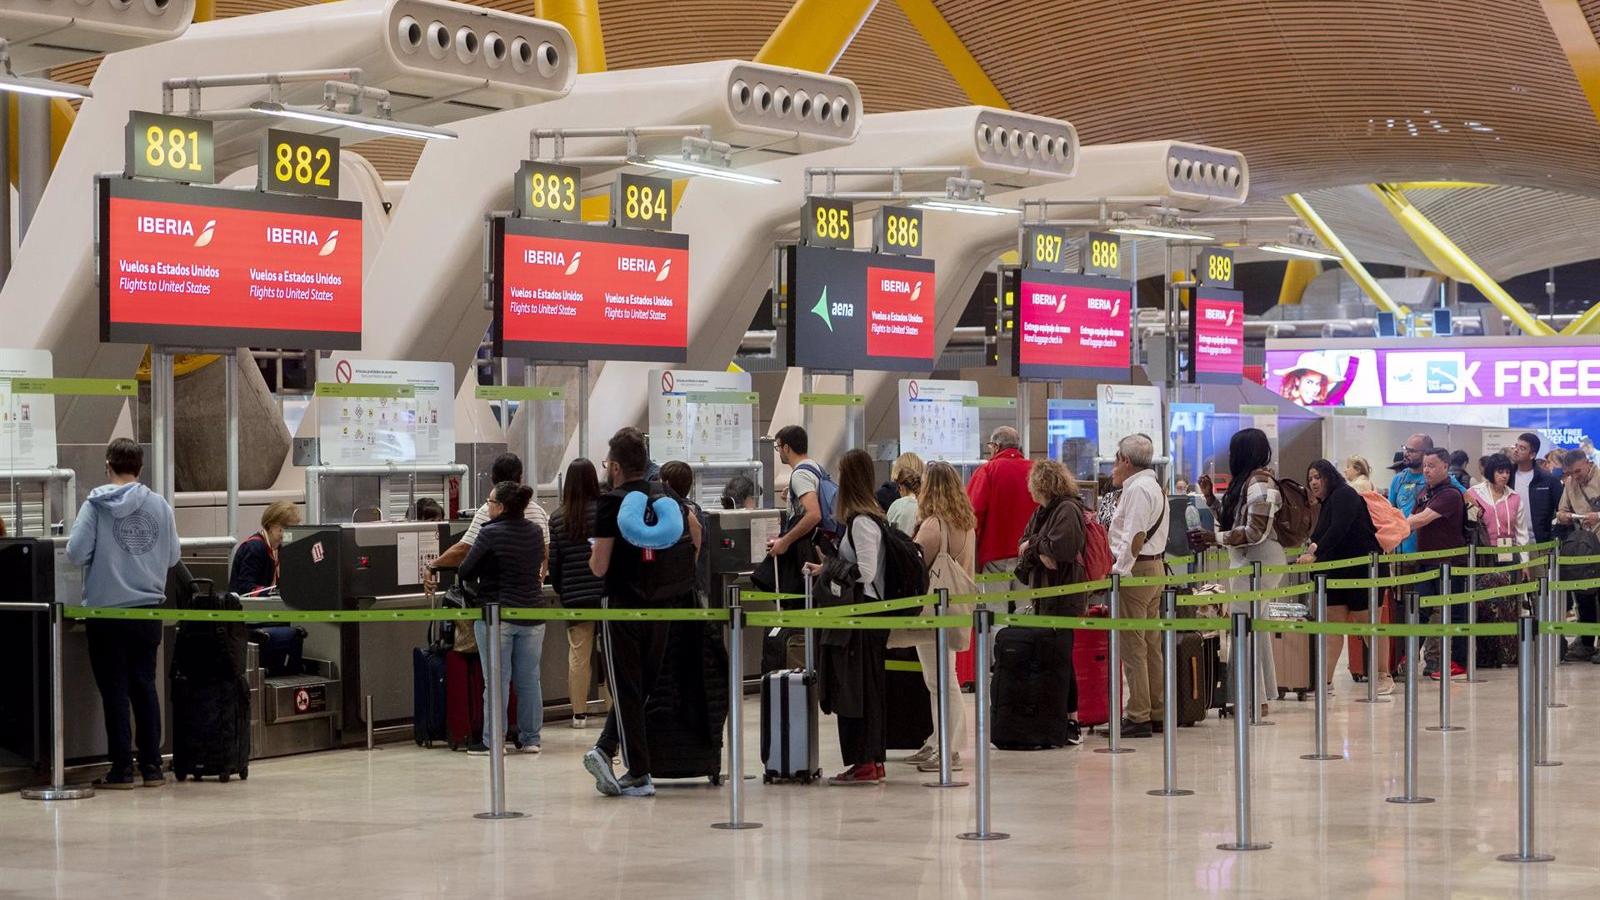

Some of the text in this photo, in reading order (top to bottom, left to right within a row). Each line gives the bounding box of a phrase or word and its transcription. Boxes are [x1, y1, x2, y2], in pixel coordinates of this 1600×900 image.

[146, 126, 202, 171] 881
[275, 143, 331, 187] 882
[531, 172, 576, 211] 883
[626, 184, 667, 222] 884
[137, 216, 194, 236] IBERIA
[816, 207, 850, 240] 885
[887, 215, 919, 248] 886
[266, 227, 319, 246] IBERIA
[524, 249, 565, 266] IBERIA
[1036, 234, 1062, 263] 887
[1092, 240, 1118, 268] 888
[119, 260, 220, 278] Vuelos a Estados Unidos
[617, 256, 656, 273] IBERIA
[1208, 254, 1231, 282] 889
[249, 268, 342, 285] Vuelos a Estados Unidos
[119, 277, 211, 295] Flights to United States
[249, 285, 333, 301] Flights to United States
[510, 287, 583, 302] Vuelos a Estados Unidos
[881, 279, 911, 294] IBERIA
[510, 301, 576, 316] Flights to United States
[604, 292, 673, 307] Vuelos a Estados Unidos
[1032, 293, 1057, 306] IBERIA
[1087, 297, 1111, 311] IBERIA
[604, 307, 667, 320] Flights to United States
[831, 302, 854, 317] aena
[1494, 359, 1600, 397] FREE
